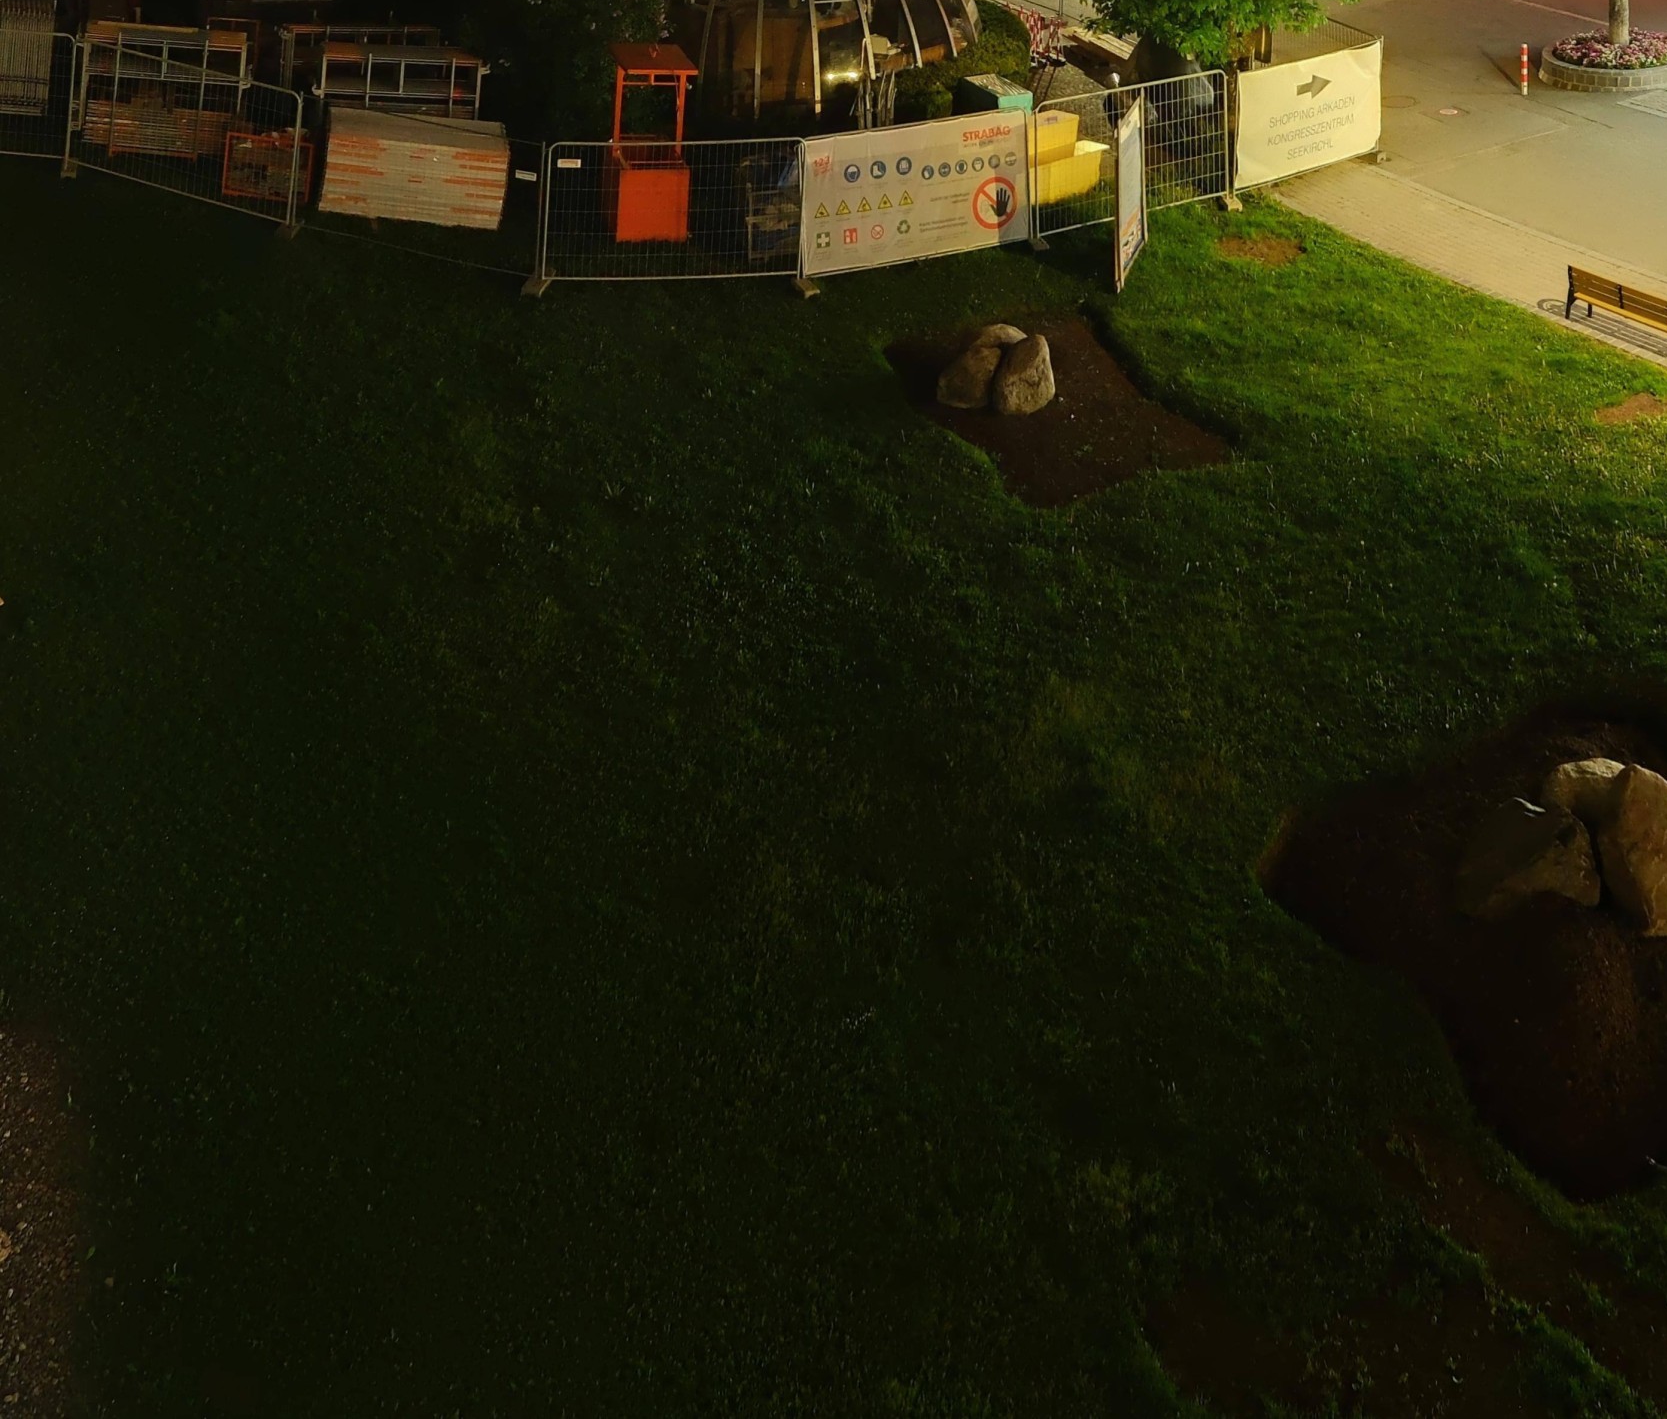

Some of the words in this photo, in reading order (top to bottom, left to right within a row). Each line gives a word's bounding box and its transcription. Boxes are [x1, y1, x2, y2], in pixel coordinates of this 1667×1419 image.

[1268, 107, 1316, 130] SHOPPING
[1316, 95, 1356, 117] ARKADEN
[962, 125, 1012, 142] STRABAG
[1266, 113, 1355, 148] KONGRESSZENTRUM
[1286, 138, 1335, 161] SEEKIRCHL
